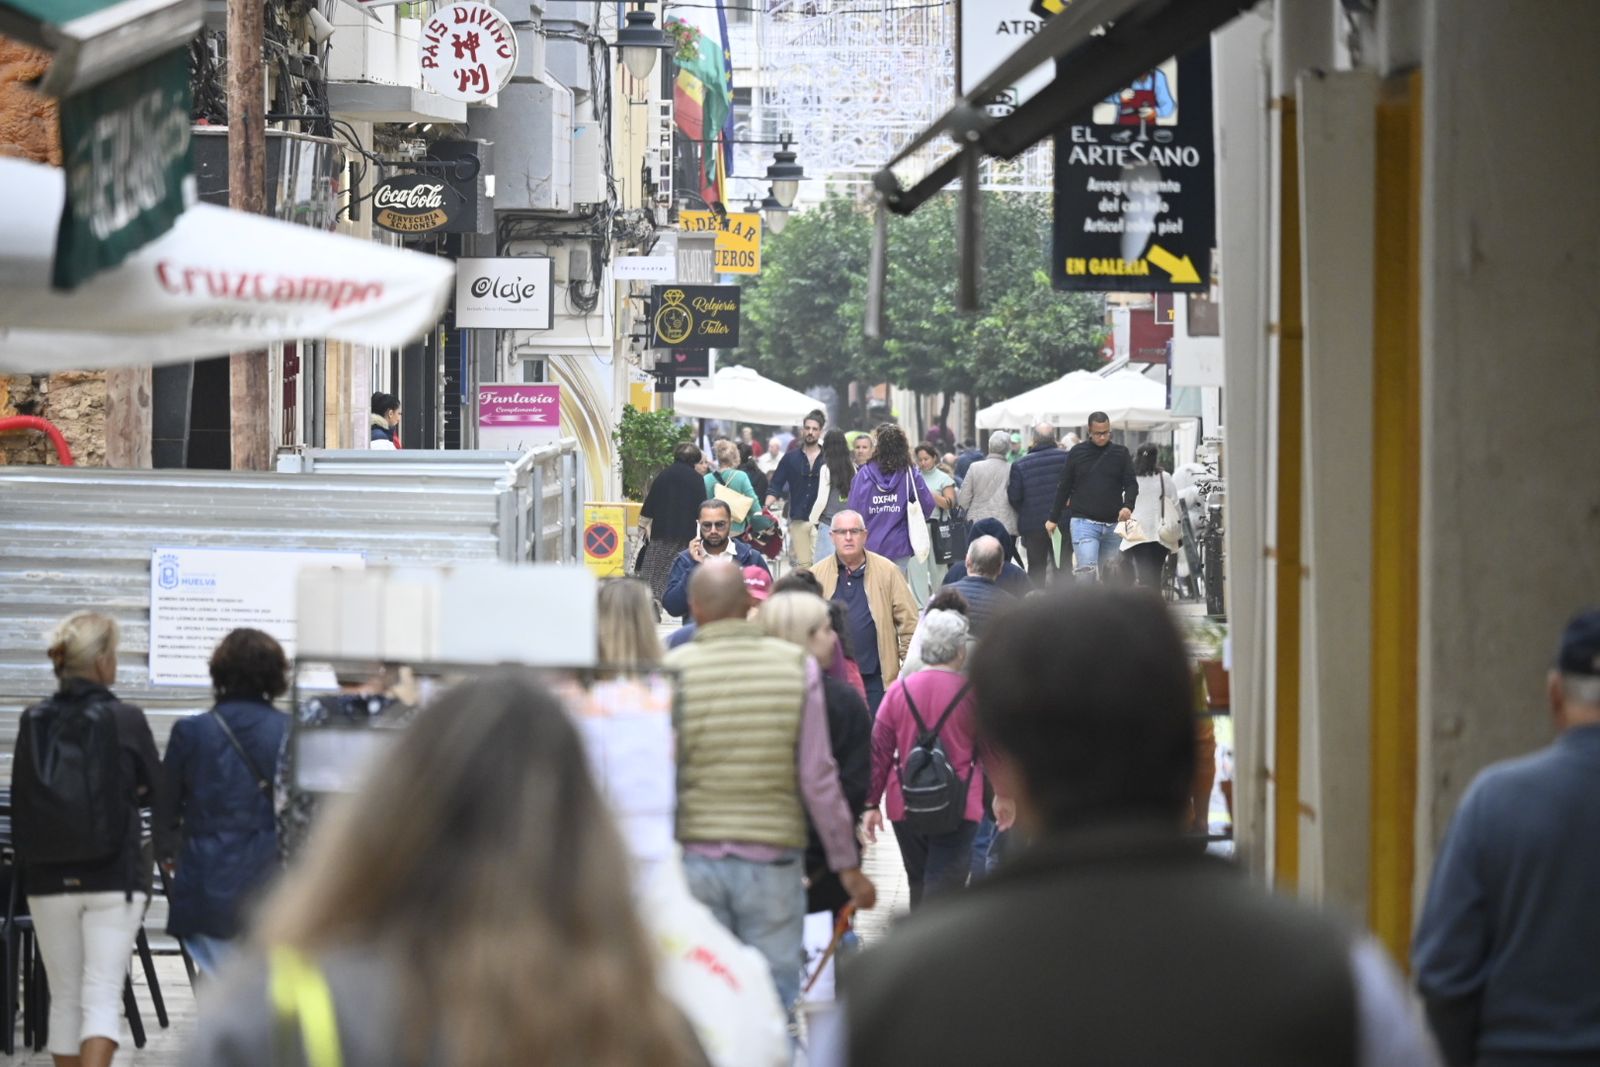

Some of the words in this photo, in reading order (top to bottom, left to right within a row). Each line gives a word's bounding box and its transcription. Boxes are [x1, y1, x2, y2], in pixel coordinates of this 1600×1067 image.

[1071, 125, 1098, 143] EL
[1068, 141, 1200, 170] ARTESANO
[1066, 257, 1087, 275] EN
